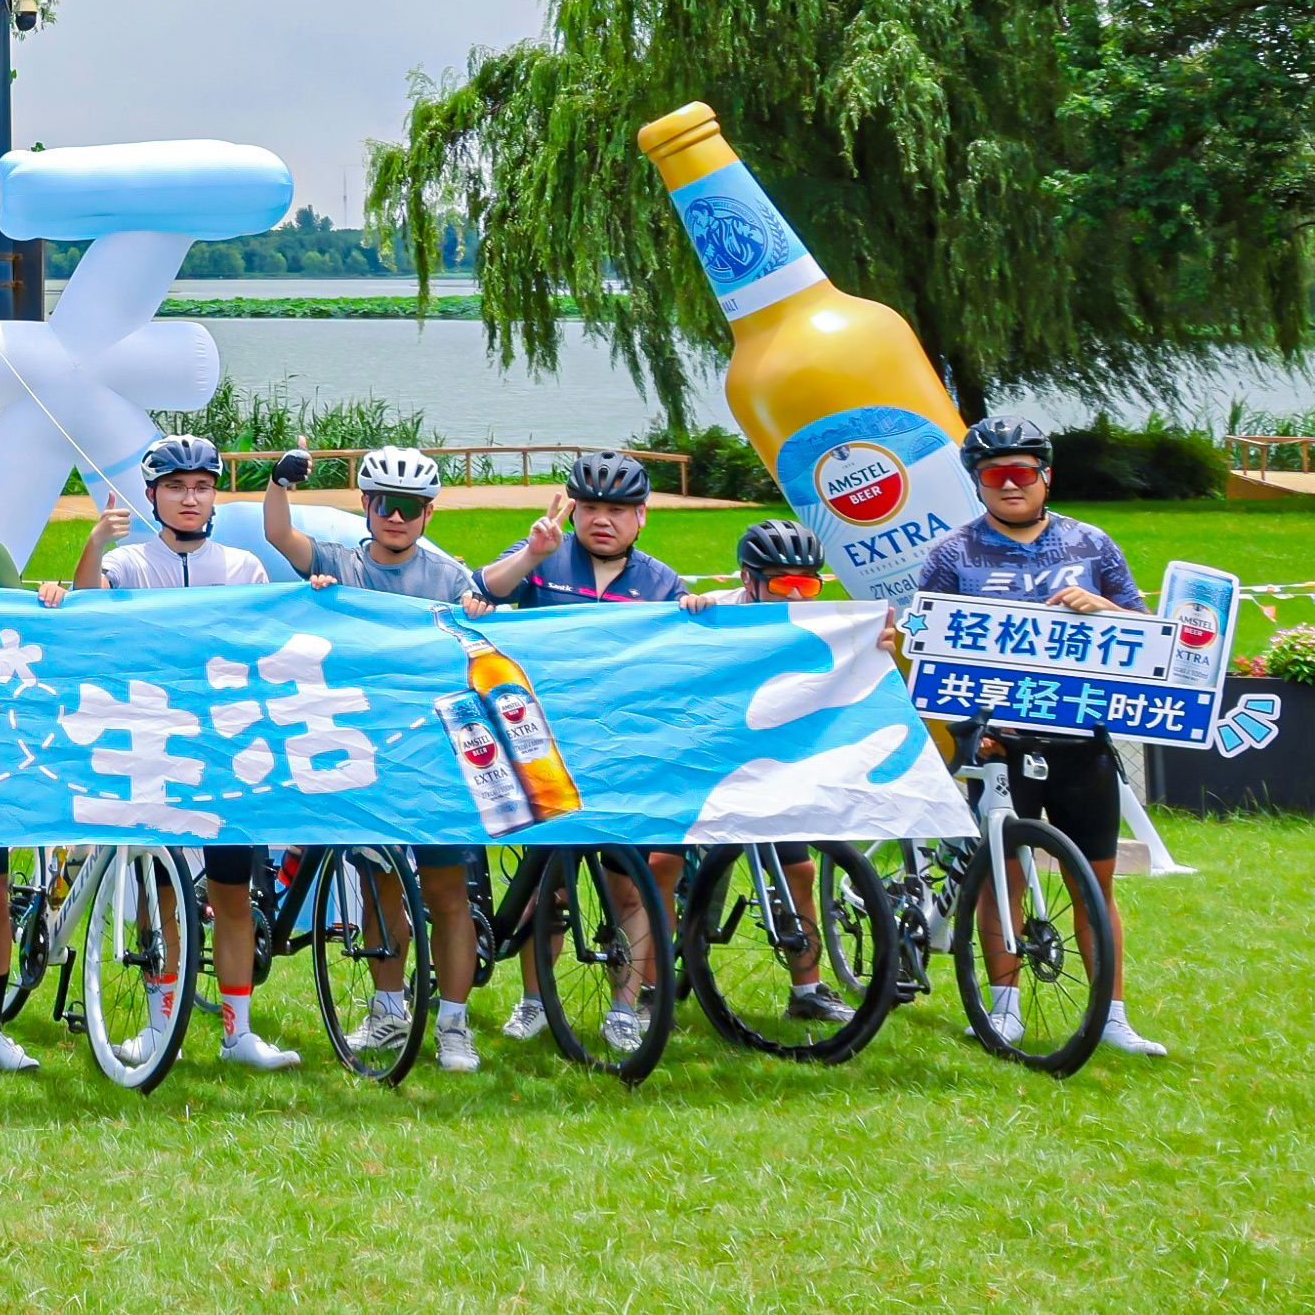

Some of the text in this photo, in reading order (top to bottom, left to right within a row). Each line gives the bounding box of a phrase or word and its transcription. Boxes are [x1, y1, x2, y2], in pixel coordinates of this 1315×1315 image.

[827, 461, 892, 496] AMSTEL
[849, 486, 884, 506] BEER
[843, 511, 953, 569] EXTRA
[547, 582, 574, 592] Santic
[869, 572, 920, 600] 27kcal
[1178, 615, 1214, 631] AMSTEL
[944, 608, 1145, 668] 轻松骑行
[1175, 649, 1210, 666] XTRA
[935, 672, 1186, 732] 共享轻卡时光
[473, 767, 509, 785] EXTRA
